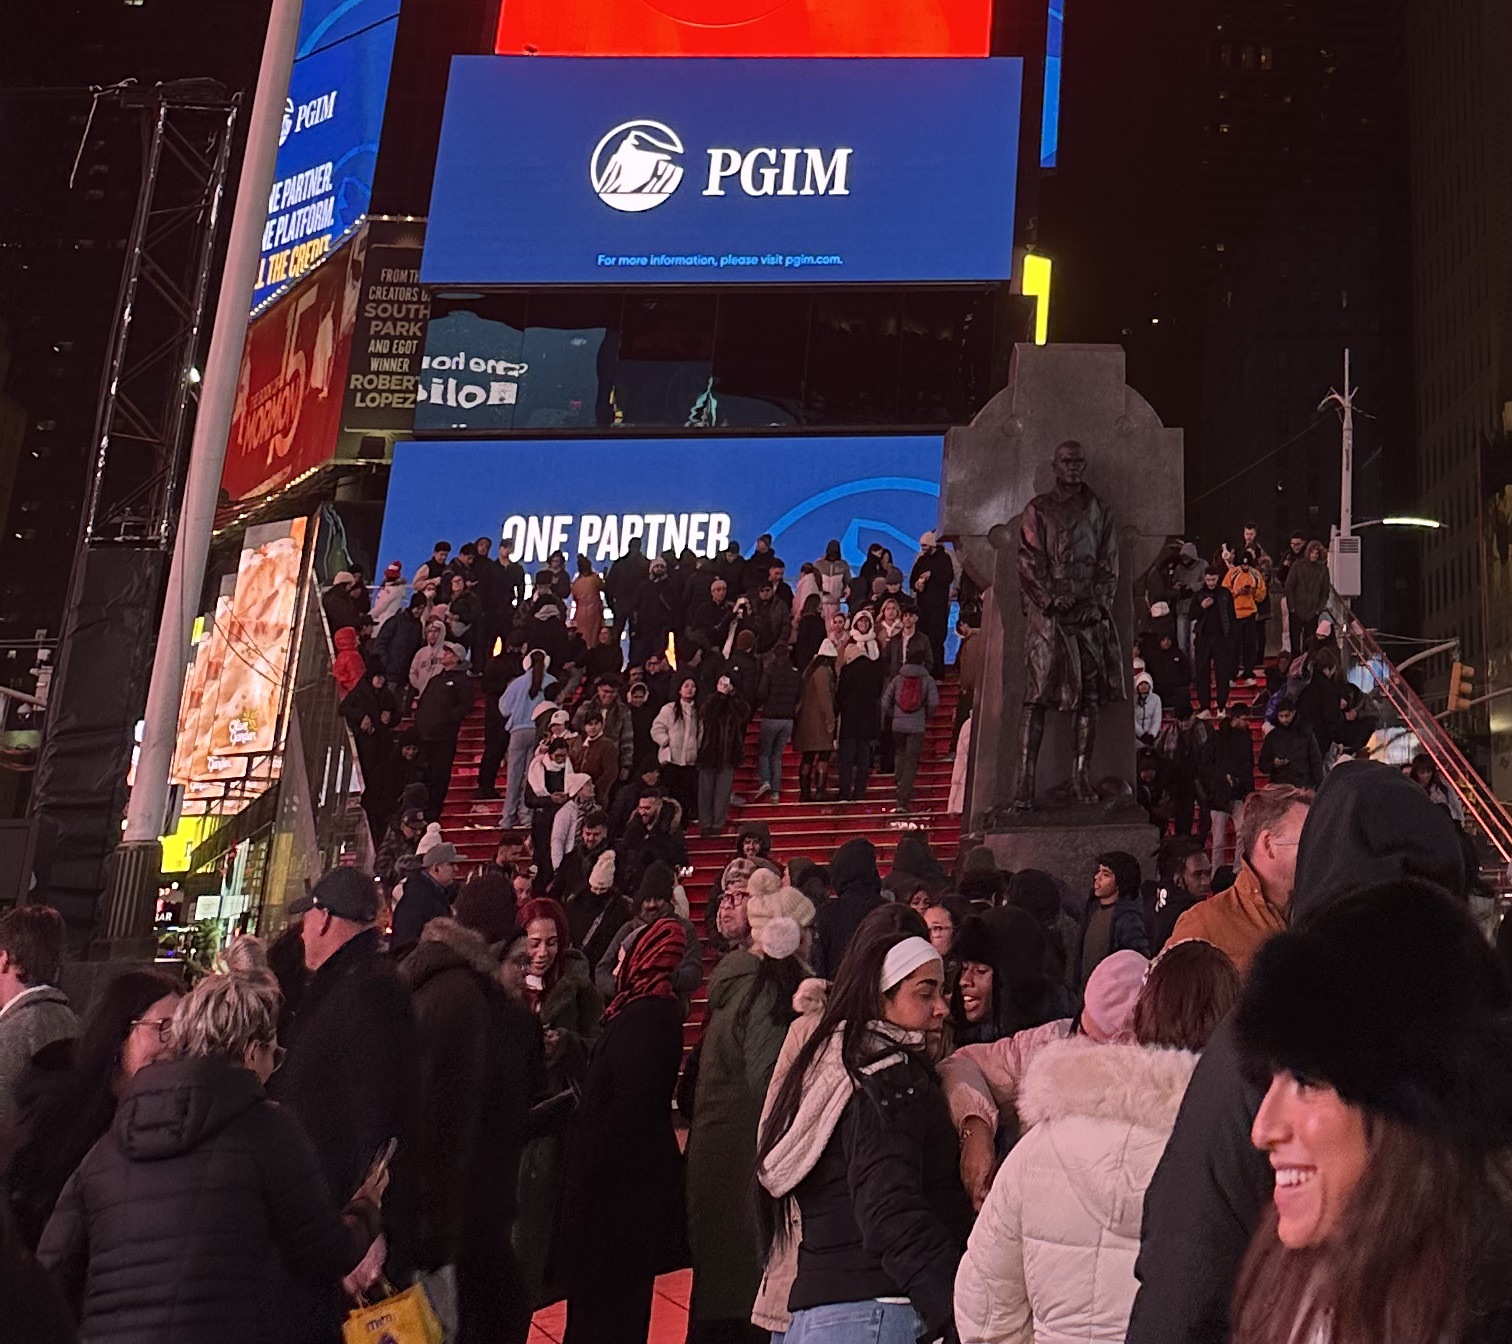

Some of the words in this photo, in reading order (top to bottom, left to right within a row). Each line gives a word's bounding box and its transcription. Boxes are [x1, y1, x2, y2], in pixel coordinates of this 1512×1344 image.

[294, 90, 338, 133] PGIM
[701, 148, 853, 197] PGIM
[266, 248, 288, 284] THE
[597, 254, 616, 266] For
[618, 257, 648, 266] more
[650, 254, 718, 267] information,
[719, 254, 758, 268] please
[760, 254, 783, 265] visit
[380, 268, 412, 283] FROM
[368, 286, 418, 301] CREATORS
[364, 303, 432, 319] SOUTH
[369, 320, 423, 337] PARK
[368, 340, 389, 354] AND
[392, 340, 418, 354] EGOT
[370, 357, 410, 372] WINNER
[355, 392, 415, 408] LOPEZ
[502, 515, 574, 563] ONE
